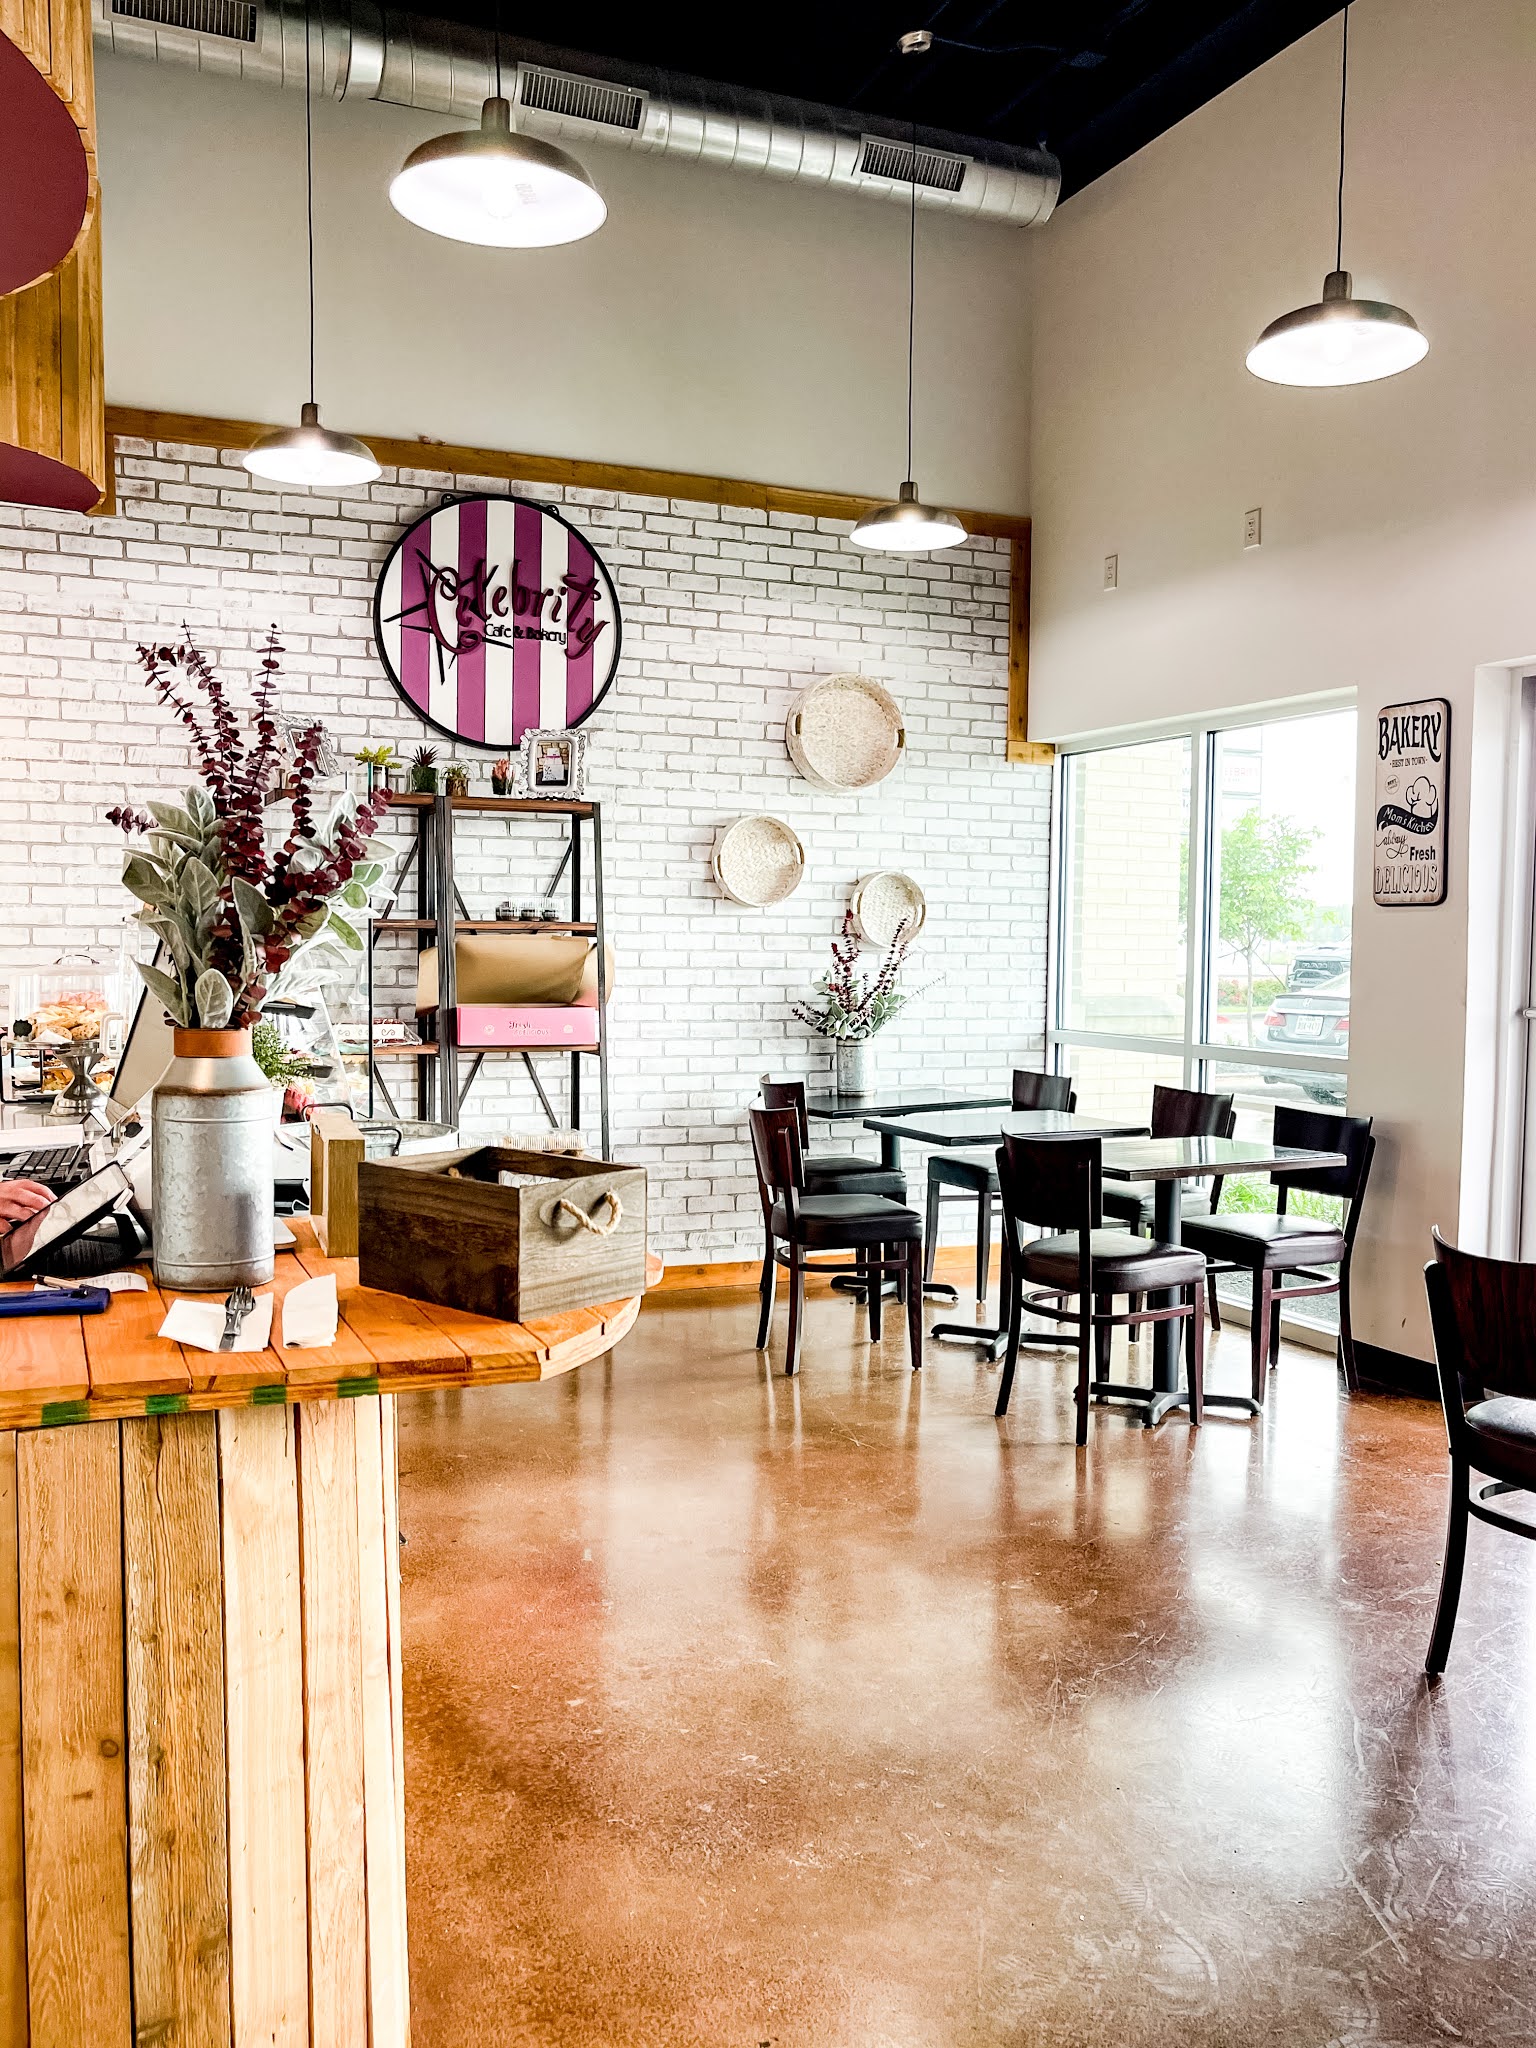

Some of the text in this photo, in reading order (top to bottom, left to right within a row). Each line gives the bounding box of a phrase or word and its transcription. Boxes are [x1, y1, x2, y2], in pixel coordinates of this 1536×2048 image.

[427, 558, 611, 660] Celebrity
[484, 623, 567, 645] Cafe & Bakery
[1378, 711, 1442, 763] BAKERY
[1405, 758, 1411, 767] IN
[1383, 806, 1435, 833] Mom's Kitchen
[1409, 846, 1436, 861] Fresh
[1375, 863, 1438, 894] DELICIOUS
